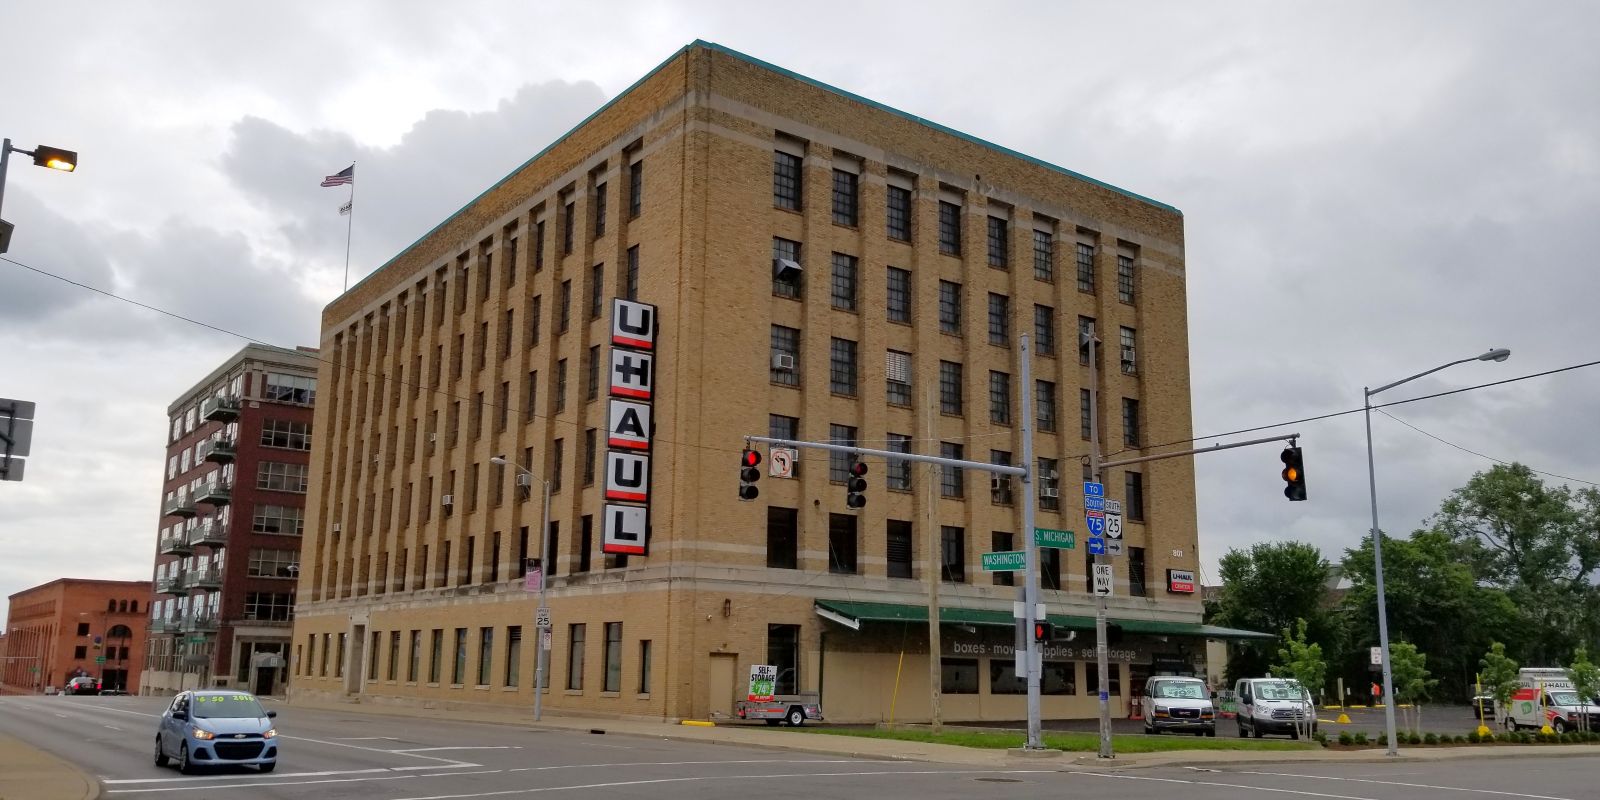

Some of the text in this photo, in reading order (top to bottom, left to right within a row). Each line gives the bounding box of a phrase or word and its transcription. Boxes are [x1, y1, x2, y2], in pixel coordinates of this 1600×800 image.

[1089, 485, 1099, 494] TO
[1086, 498, 1104, 507] SOUTH
[1106, 501, 1120, 510] SOUTH
[1088, 518, 1102, 531] 75
[1108, 518, 1120, 533] 25
[1035, 530, 1073, 543] S. MICHIGAN
[983, 553, 1026, 566] WASHINGTON
[1096, 566, 1109, 575] ONE
[1096, 577, 1110, 587] WAY
[537, 617, 549, 625] 25
[953, 641, 985, 653] boxes
[1107, 647, 1136, 661] torage
[751, 674, 775, 682] STORAGE
